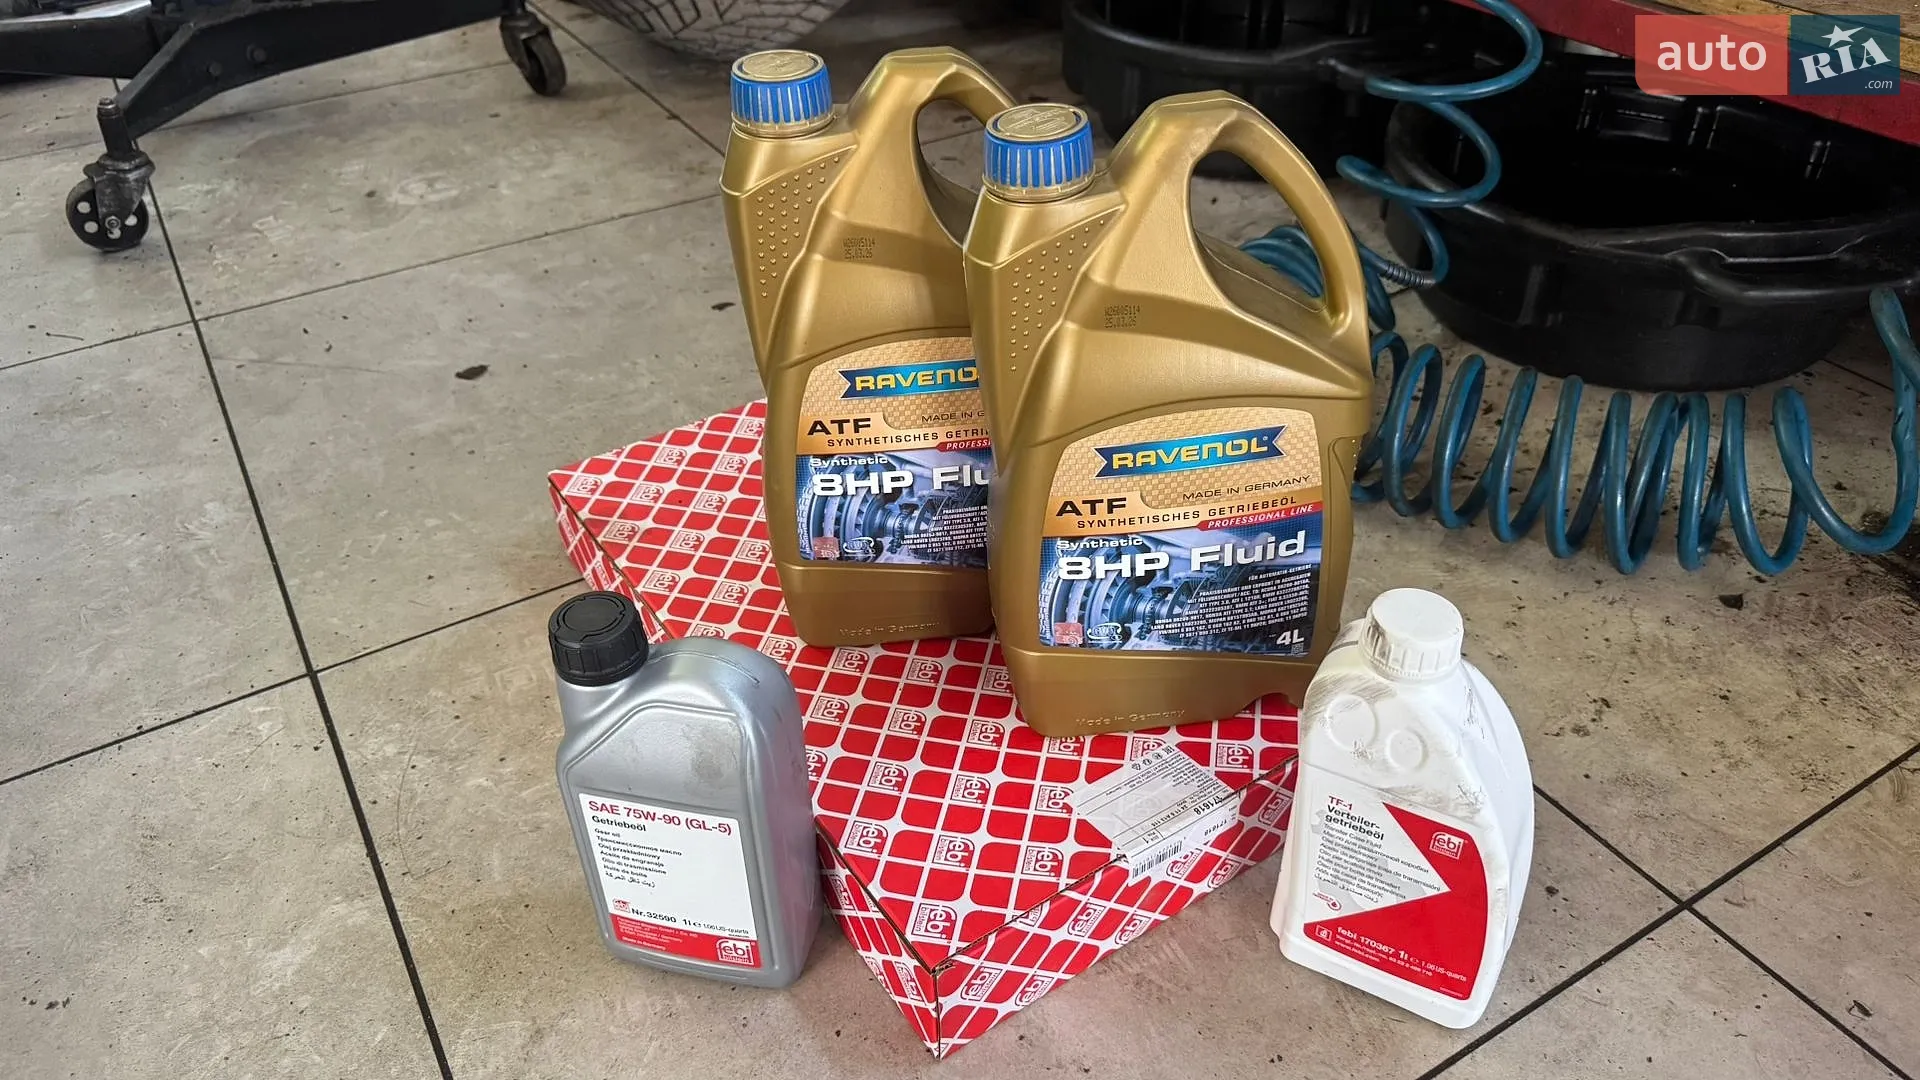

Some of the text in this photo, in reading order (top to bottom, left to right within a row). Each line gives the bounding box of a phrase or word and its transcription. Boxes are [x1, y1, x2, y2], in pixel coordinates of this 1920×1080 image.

[855, 367, 979, 391] RAVENO
[808, 418, 871, 436] ATF
[921, 413, 957, 424] MADE
[828, 432, 939, 447] SYNTHETISCHES
[810, 456, 888, 467] Synthetic
[1112, 436, 1268, 470] RAVENOL
[812, 465, 989, 496] 8HP Flu
[1182, 475, 1311, 501] MADE IN GERMANY
[1056, 497, 1127, 517] ATF
[1077, 495, 1297, 529] SYNTHETISCHES GETRIEBEÖL
[1207, 504, 1314, 529] PROFESSIONAL LINE
[1056, 538, 1144, 551] Synthetic
[1058, 530, 1305, 580] 8HP Fluid
[1276, 630, 1305, 646] 4L
[1329, 796, 1353, 811] TF-1
[588, 800, 732, 836] SAE 75W-90 (GL-5)
[591, 815, 647, 832] Getriebeöl
[1325, 814, 1385, 841] getriebeöl
[1327, 804, 1381, 829] Verteiler-
[1432, 832, 1462, 853] febi
[717, 939, 752, 958] febi
[1337, 927, 1357, 941] febi
[1360, 936, 1395, 954] 170367
